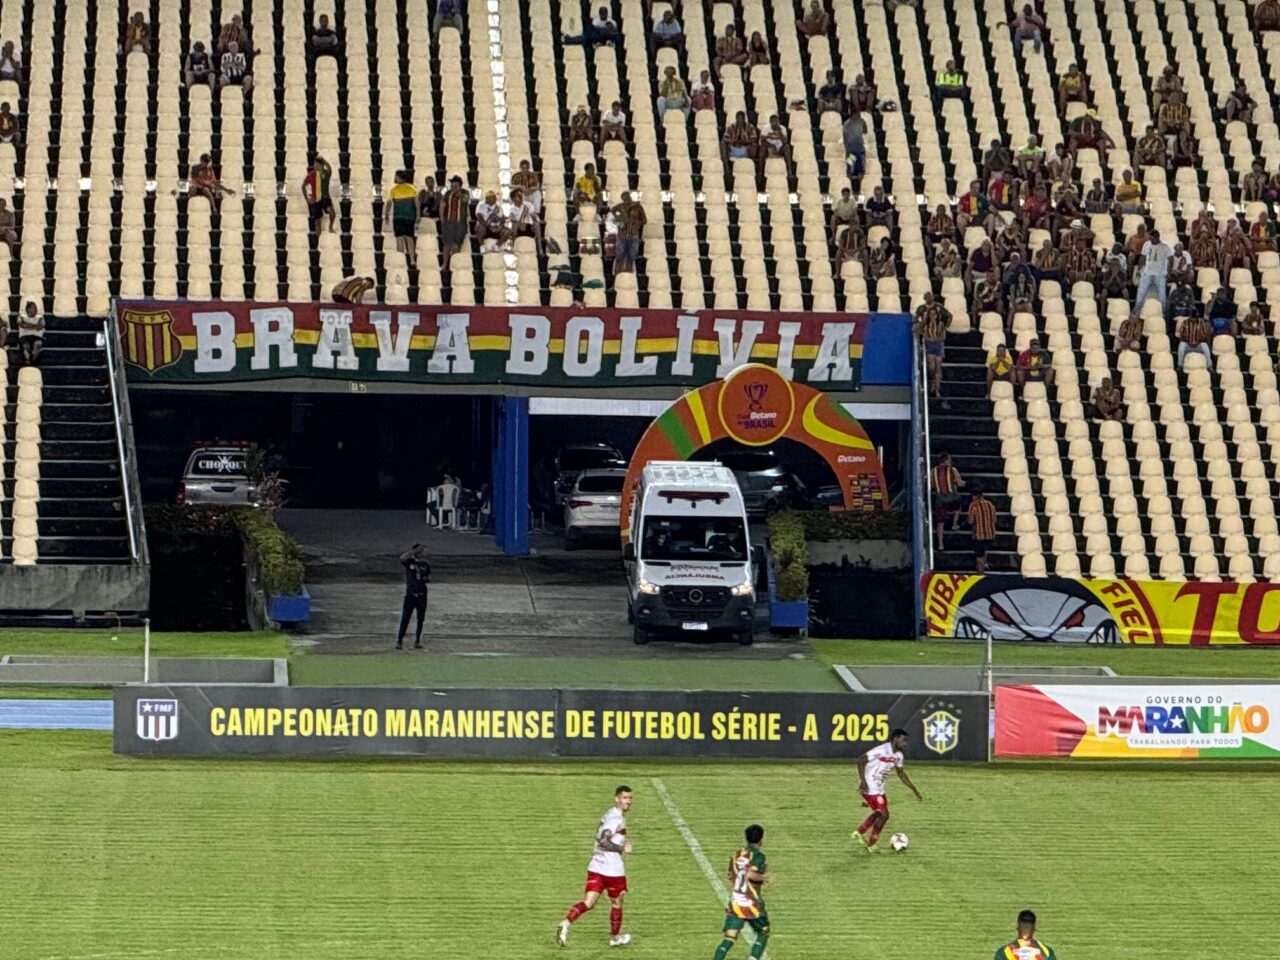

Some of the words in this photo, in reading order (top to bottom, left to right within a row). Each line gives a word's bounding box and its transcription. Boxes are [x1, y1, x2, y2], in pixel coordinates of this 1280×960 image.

[192, 307, 475, 374] BRAVA
[154, 703, 174, 713] FMF
[1146, 695, 1202, 704] GOVERNO
[1207, 695, 1223, 704] DO
[210, 707, 378, 737] CAMPEONATO
[385, 709, 555, 739] MARANHENSE
[565, 710, 595, 739] DE
[602, 710, 705, 740] FUTEBOL
[711, 706, 781, 741] SÉRIE
[803, 712, 819, 741] A
[831, 713, 890, 742] 2025
[1098, 702, 1270, 734] MARANHÃO
